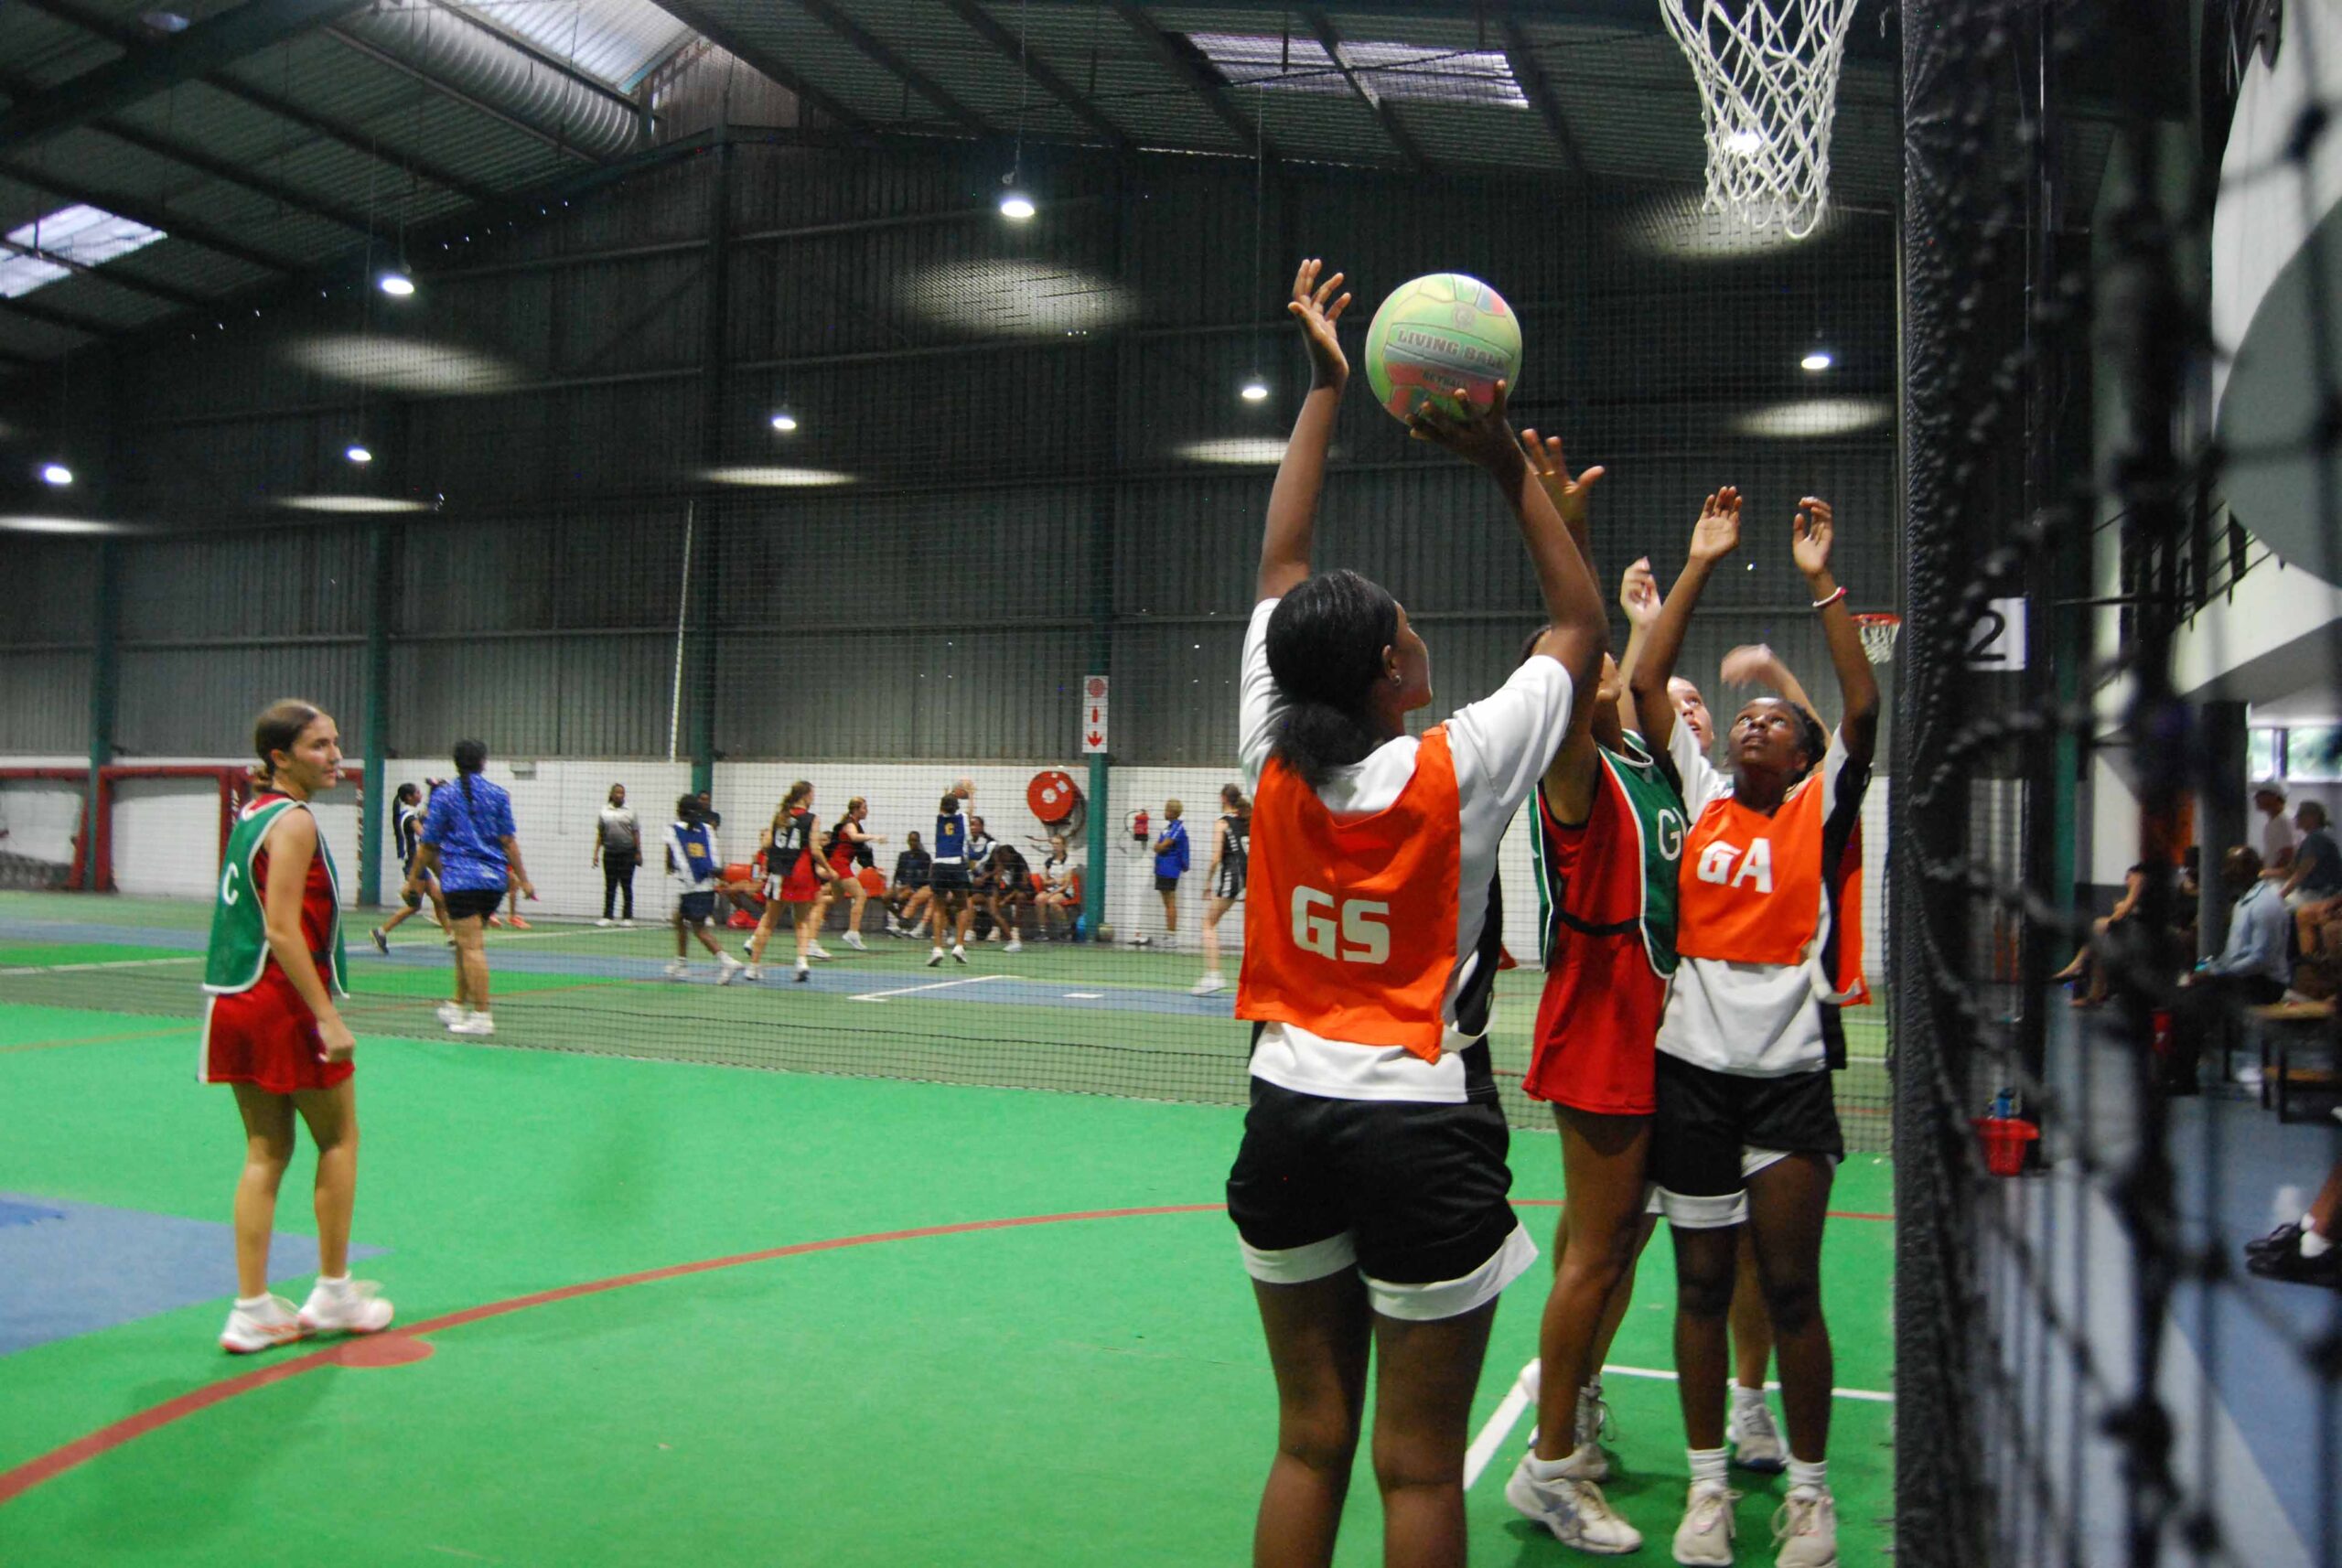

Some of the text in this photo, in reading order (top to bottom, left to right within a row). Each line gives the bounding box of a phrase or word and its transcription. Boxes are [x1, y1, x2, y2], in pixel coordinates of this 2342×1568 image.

[1397, 328, 1459, 355] LIVING
[1968, 609, 2006, 661] 2
[774, 827, 801, 849] GA
[222, 862, 239, 906] C
[1696, 837, 1773, 894] GA
[1291, 885, 1391, 964] GS
